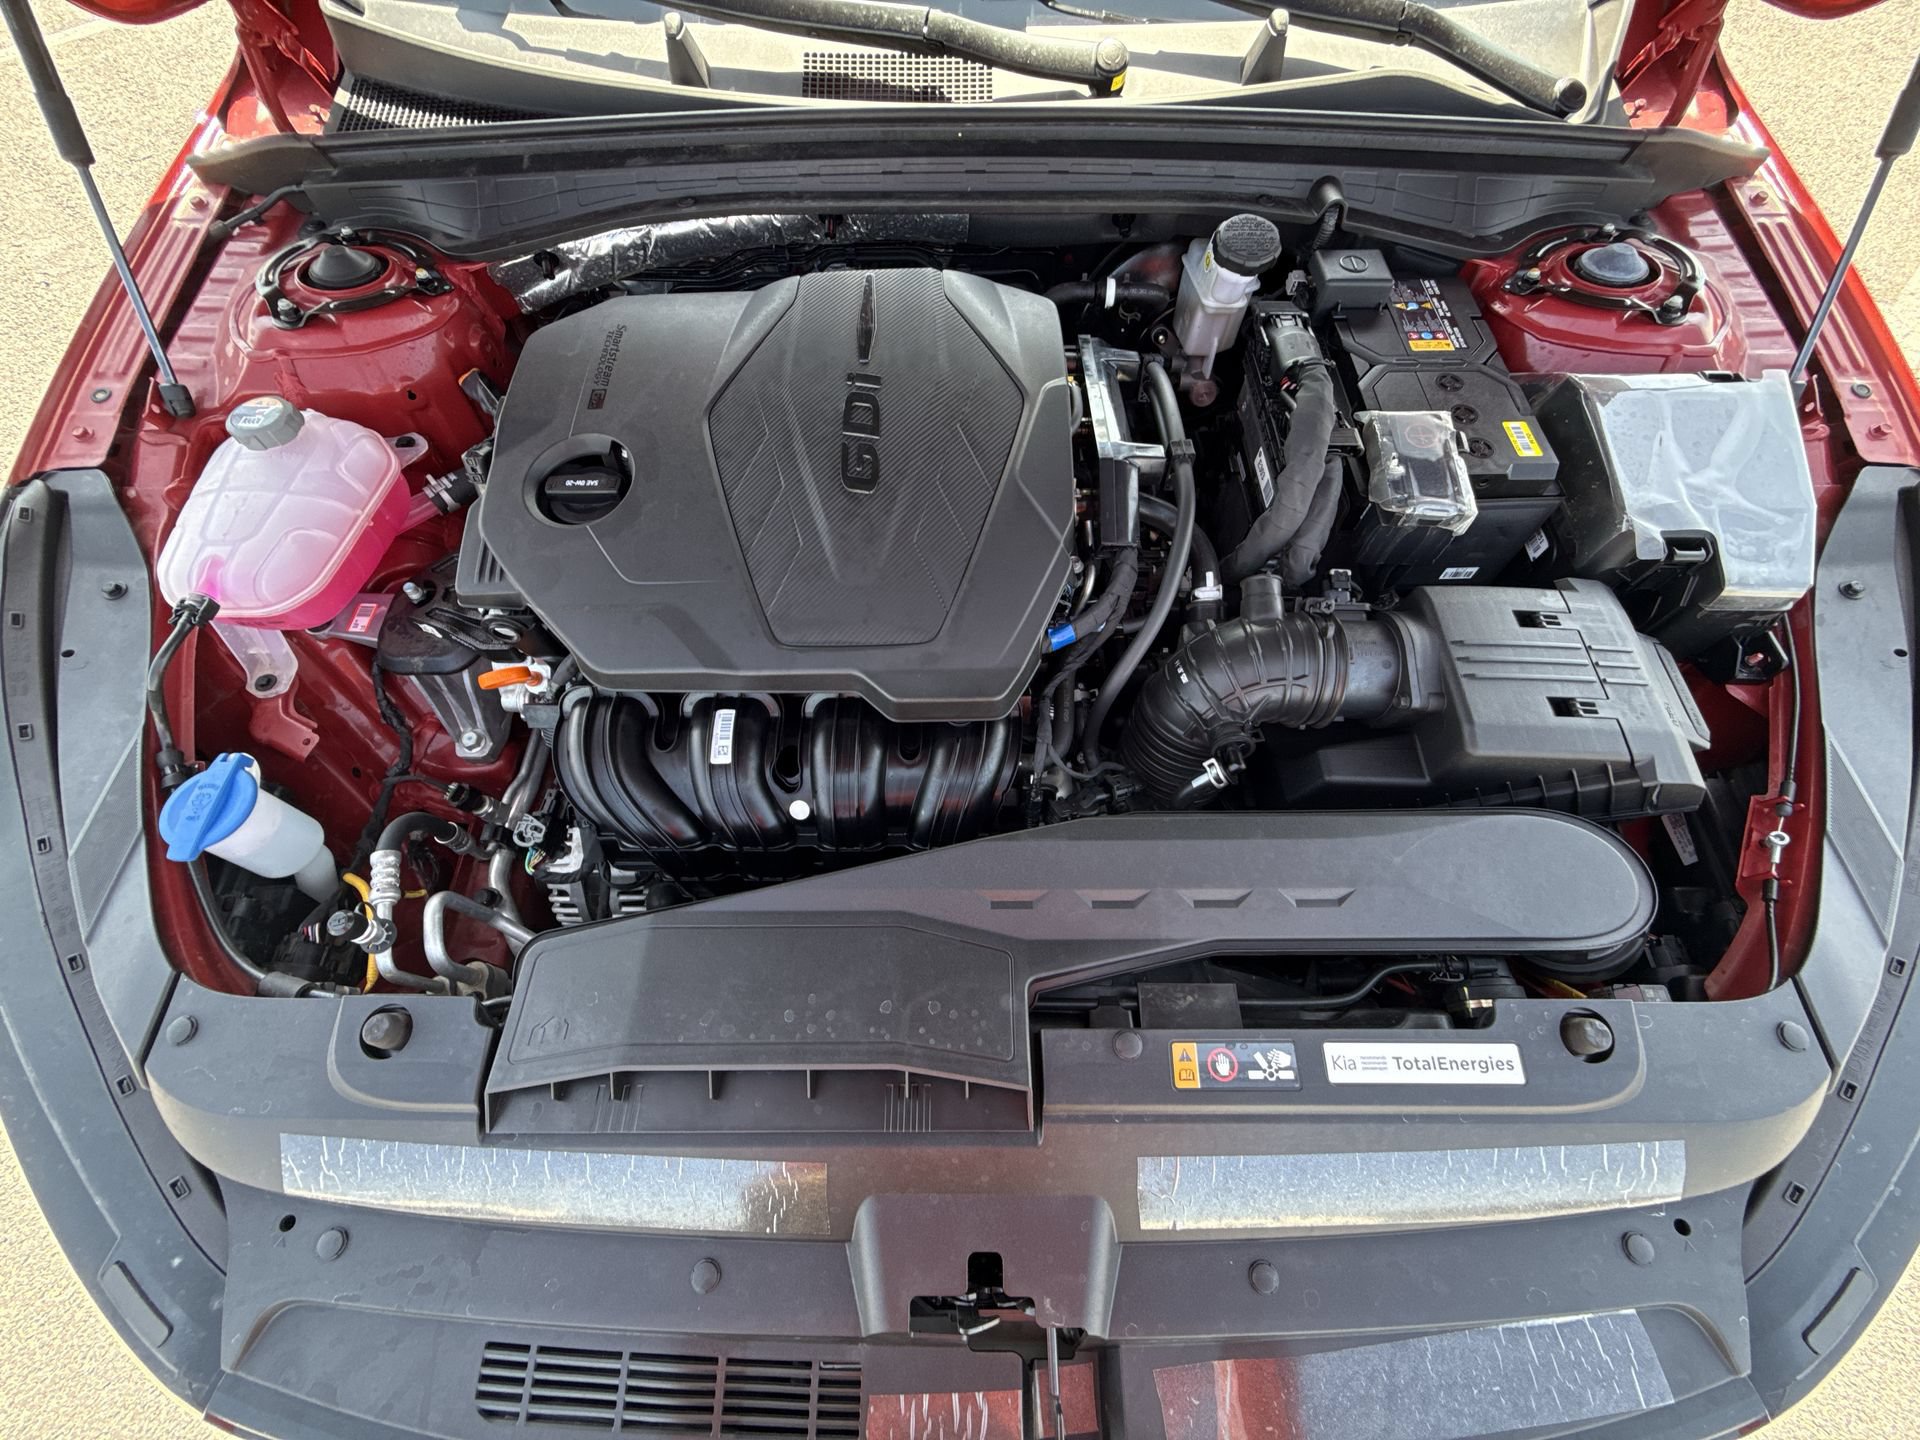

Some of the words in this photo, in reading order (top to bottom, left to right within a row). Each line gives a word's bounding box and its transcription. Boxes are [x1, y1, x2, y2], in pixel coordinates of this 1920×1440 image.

[593, 330, 615, 386] TECHNOLOGY
[600, 323, 627, 387] Smartstream
[840, 370, 882, 495] GDi
[586, 479, 599, 487] SAE
[1331, 1055, 1357, 1071] Kia
[1392, 1055, 1515, 1074] TotalEnergies
